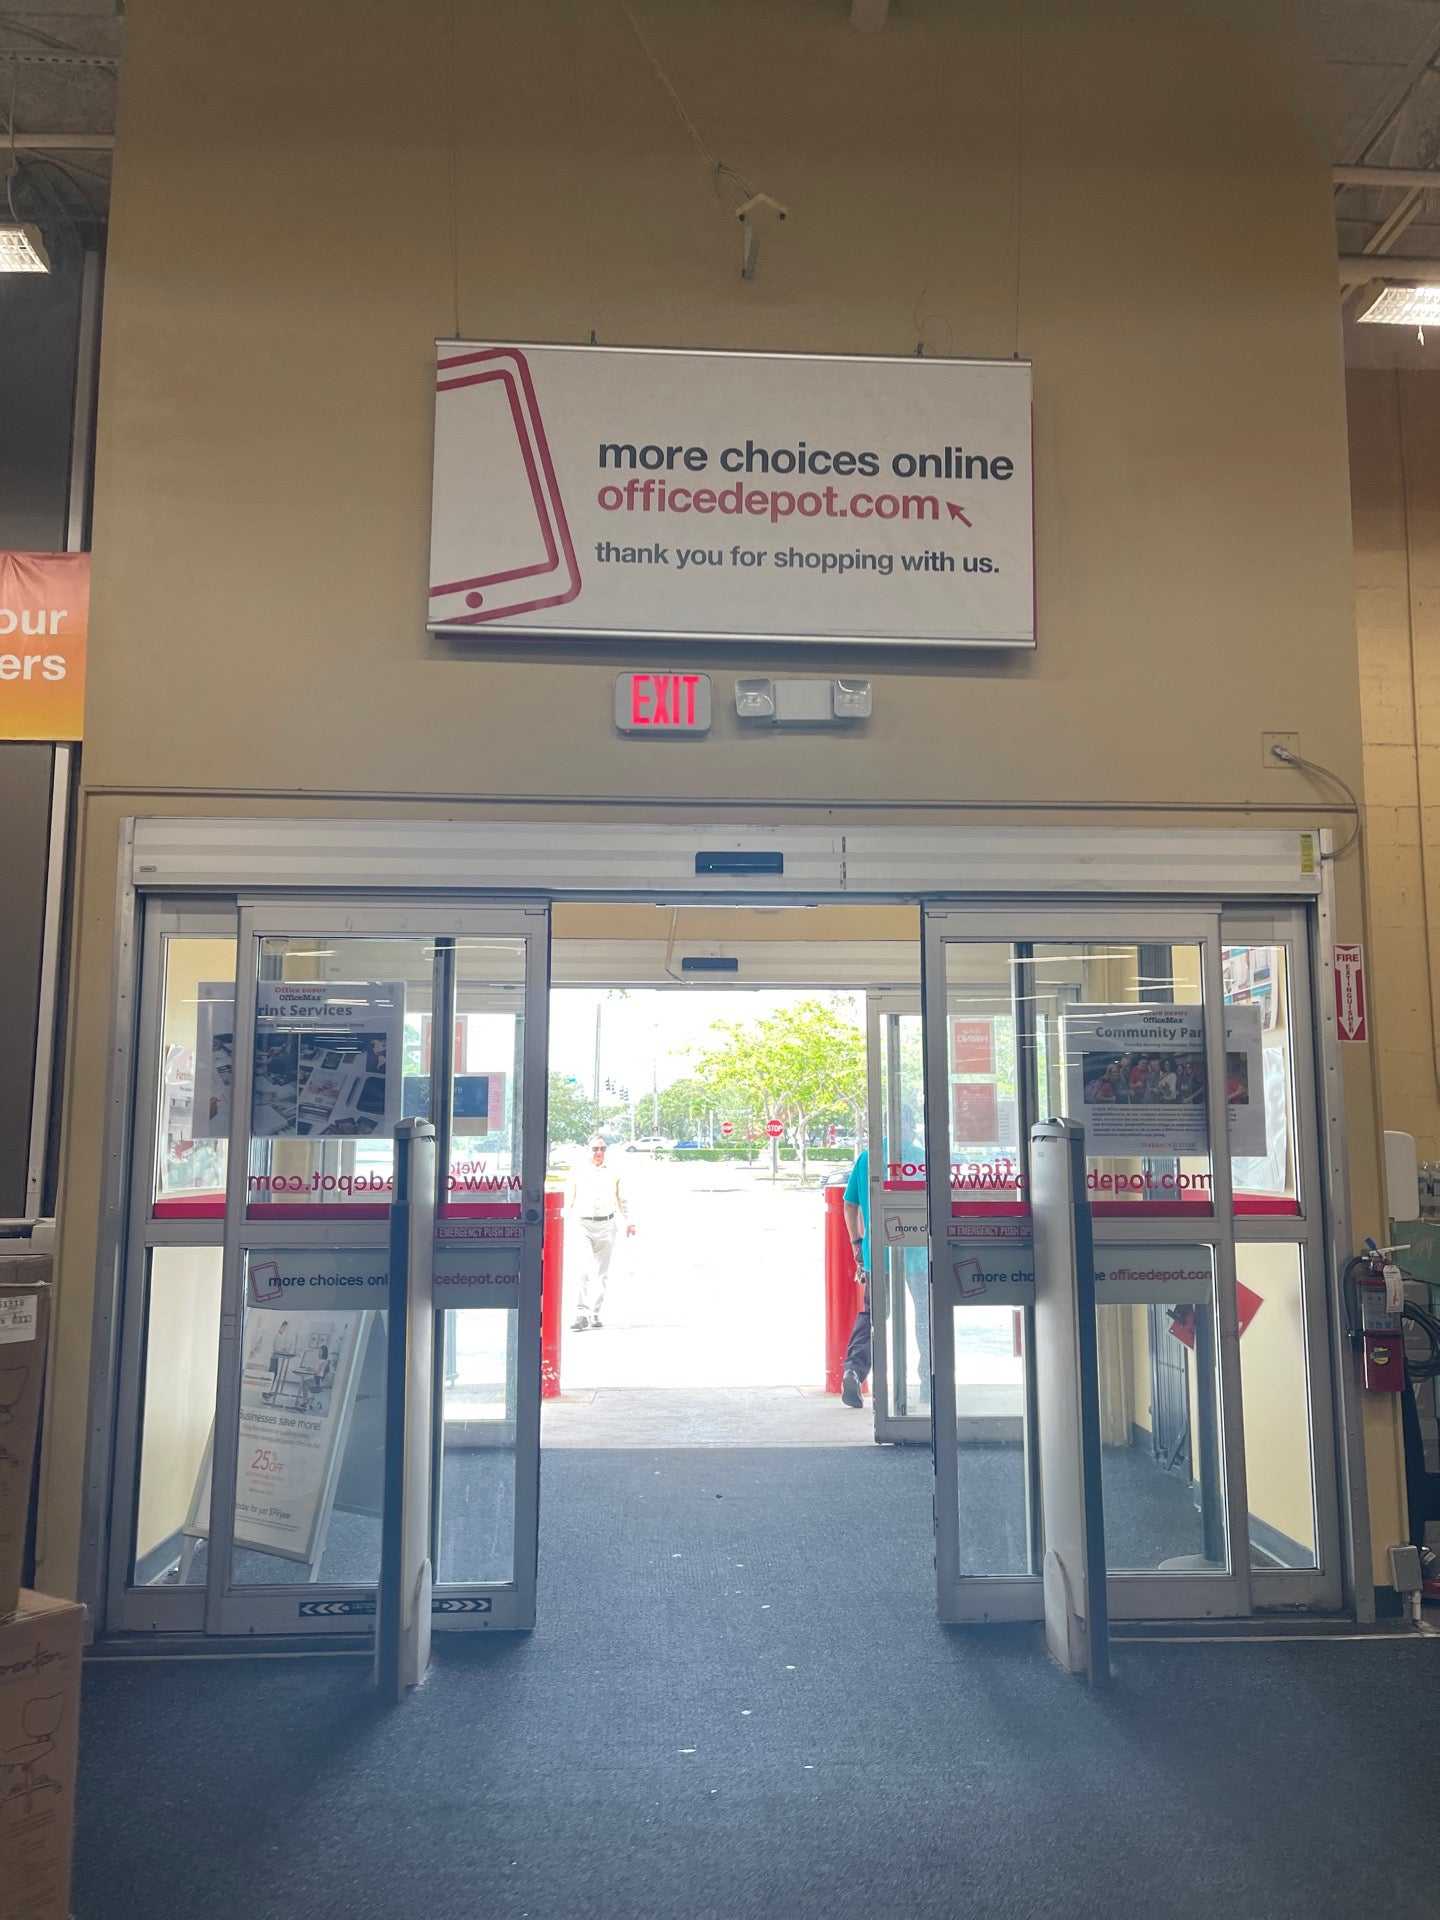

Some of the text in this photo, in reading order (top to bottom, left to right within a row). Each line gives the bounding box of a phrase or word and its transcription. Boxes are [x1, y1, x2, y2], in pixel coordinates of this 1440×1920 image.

[599, 440, 1014, 480] more choices online
[598, 478, 939, 523] officedepot.com
[595, 541, 999, 575] thank you for shopping with us.
[631, 675, 699, 725] EXIT
[1336, 953, 1360, 962] FIRE
[1345, 963, 1354, 1033] EXTINGUISHER
[258, 1004, 352, 1016] rint Services
[1096, 1027, 1176, 1041] Community
[440, 1226, 523, 1238] EMERGENCY PUSH OPEN
[948, 1226, 956, 1236] IN
[958, 1226, 998, 1236] EMERGENCY
[1000, 1226, 1019, 1236] PUSH
[269, 1276, 305, 1287] more
[309, 1274, 363, 1287] choices
[367, 1273, 388, 1286] onl
[972, 1272, 1007, 1283] more
[279, 1417, 296, 1428] save
